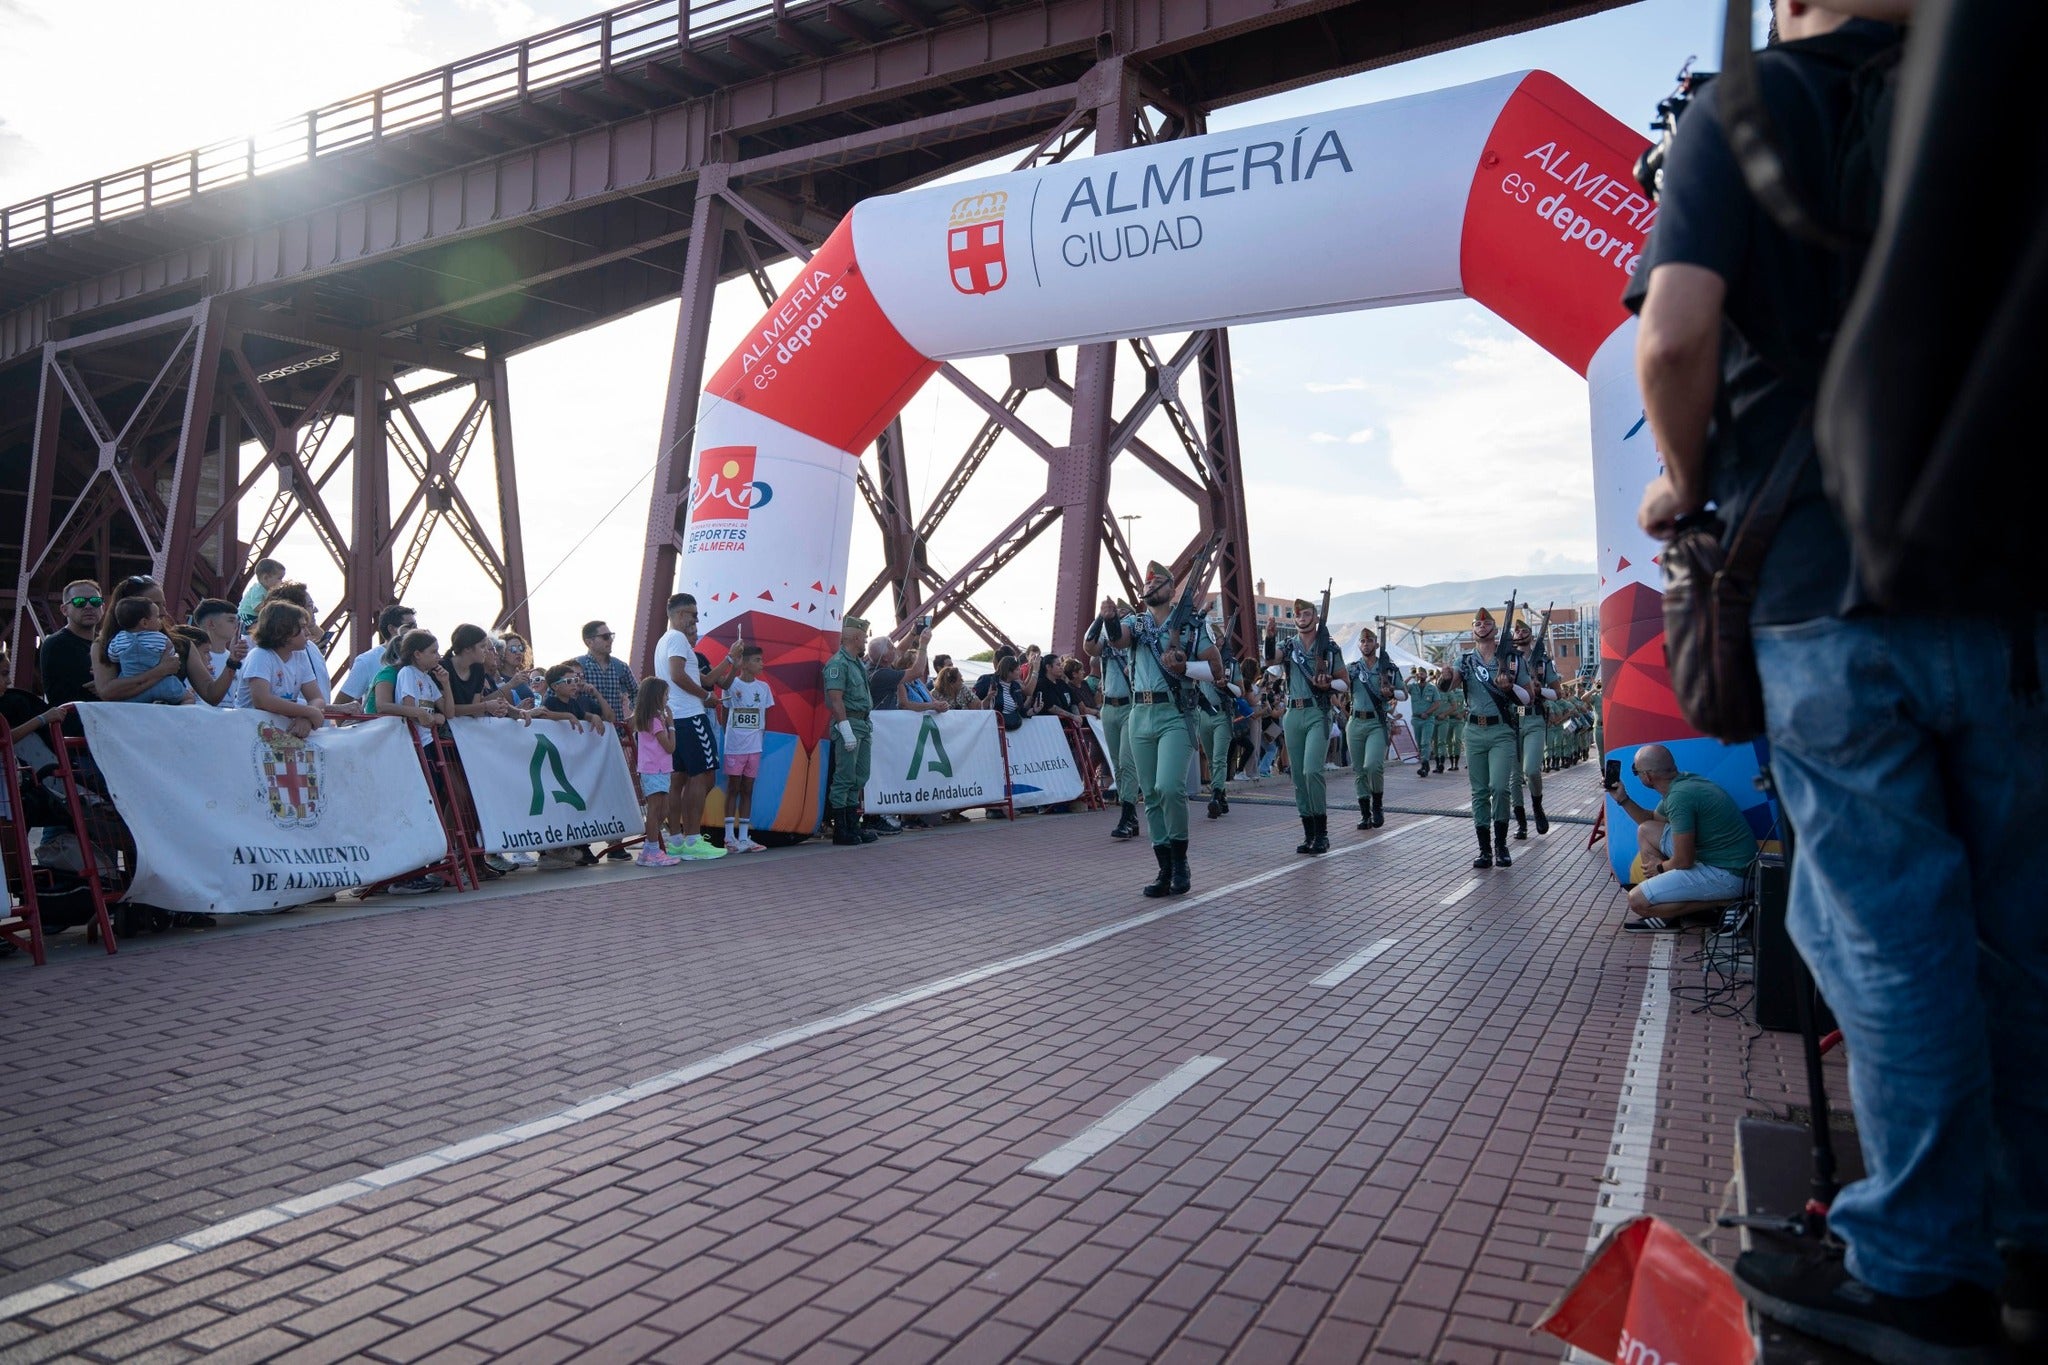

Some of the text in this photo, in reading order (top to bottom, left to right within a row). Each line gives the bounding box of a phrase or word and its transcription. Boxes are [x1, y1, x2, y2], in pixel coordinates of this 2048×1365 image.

[1061, 126, 1353, 223] ALMERÍA
[1501, 173, 1535, 203] es
[1062, 214, 1203, 267] CIUDAD
[741, 269, 830, 374] ALMERÍA
[753, 284, 847, 390] es deporte
[688, 543, 697, 554] DE
[689, 529, 747, 543] DEPORTES
[737, 714, 757, 724] 685
[1023, 756, 1069, 775] ALMERÍA
[877, 781, 983, 805] Junta de Andalucía
[501, 815, 626, 849] Junta de Andalucía
[232, 846, 370, 865] AYUNTAMIENTO
[252, 866, 362, 892] DE ALMERÍA
[1617, 1328, 1681, 1365] sm
